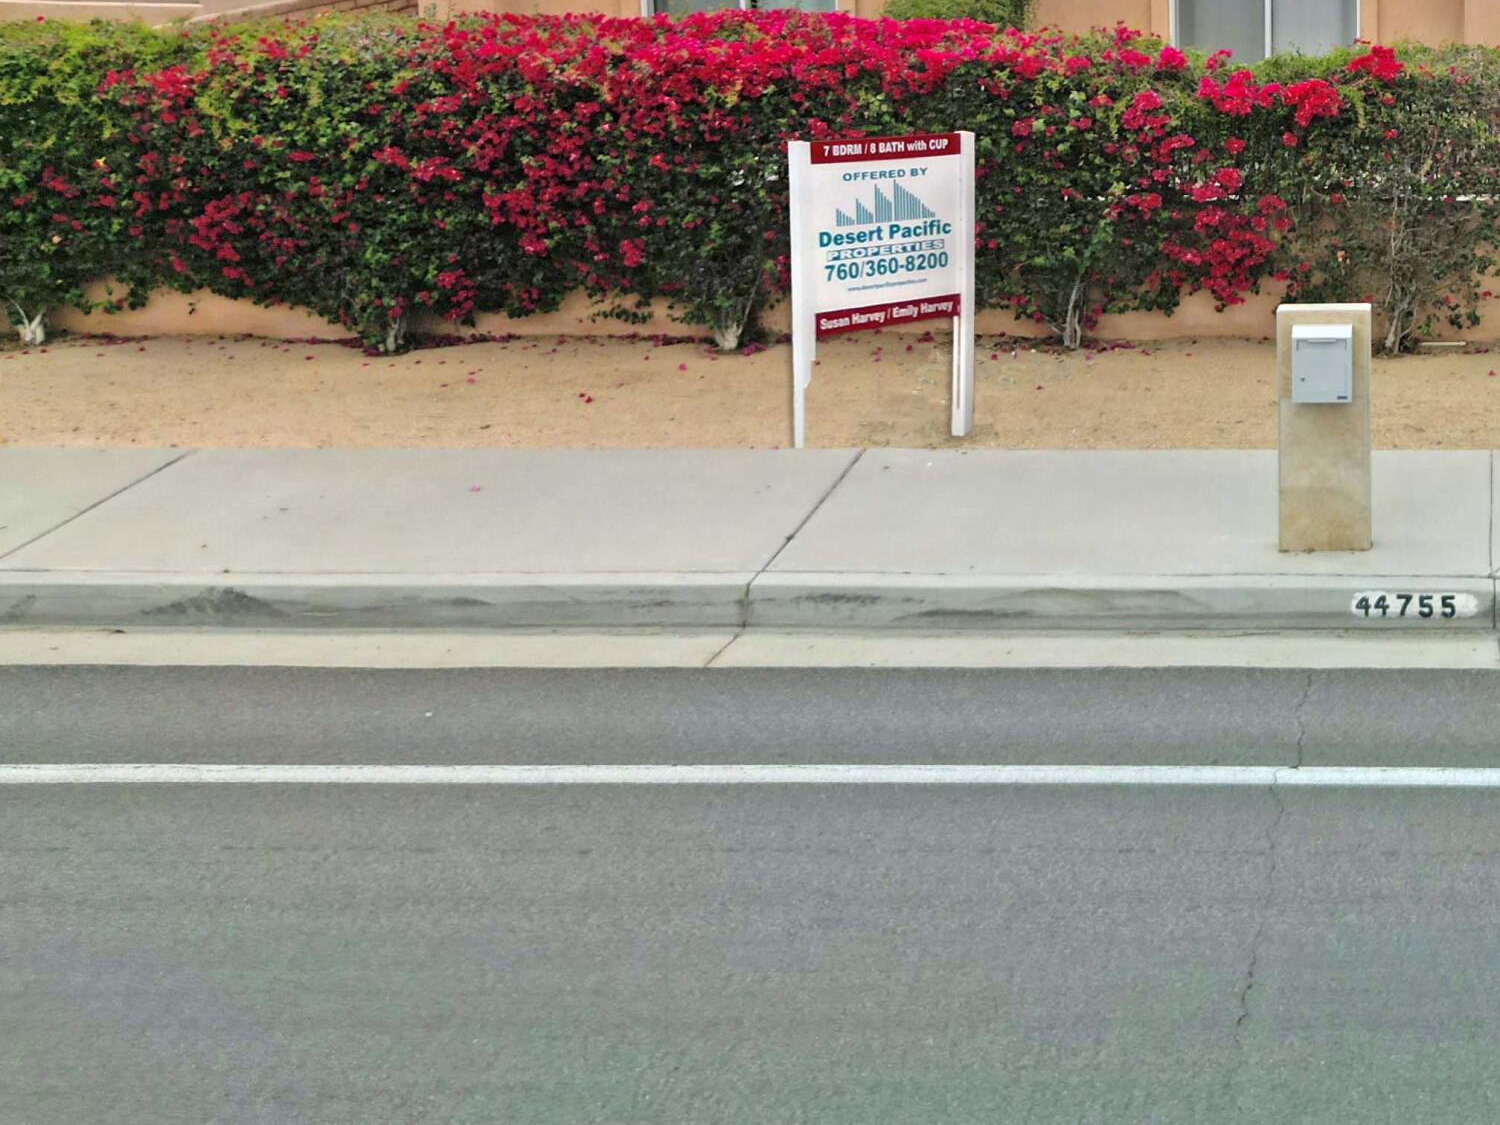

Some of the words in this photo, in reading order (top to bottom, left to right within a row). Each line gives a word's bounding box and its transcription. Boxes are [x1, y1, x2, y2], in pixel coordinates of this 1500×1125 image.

[823, 145, 829, 157] 7
[832, 144, 862, 156] BDRM
[870, 142, 876, 154] 8
[879, 141, 905, 152] BATH
[907, 139, 927, 151] with
[929, 138, 948, 150] CUP
[843, 169, 906, 182] OFFERED
[910, 167, 928, 177] BY
[819, 226, 883, 248] Desert
[889, 219, 952, 239] Pacific
[826, 238, 945, 261] PROPERTIES
[824, 251, 948, 282] 760/360-8200
[820, 318, 850, 330] Susan
[852, 312, 885, 324] Harvey
[892, 305, 919, 318] Emily
[921, 302, 953, 314] Harvey
[1355, 594, 1456, 618] 44755
